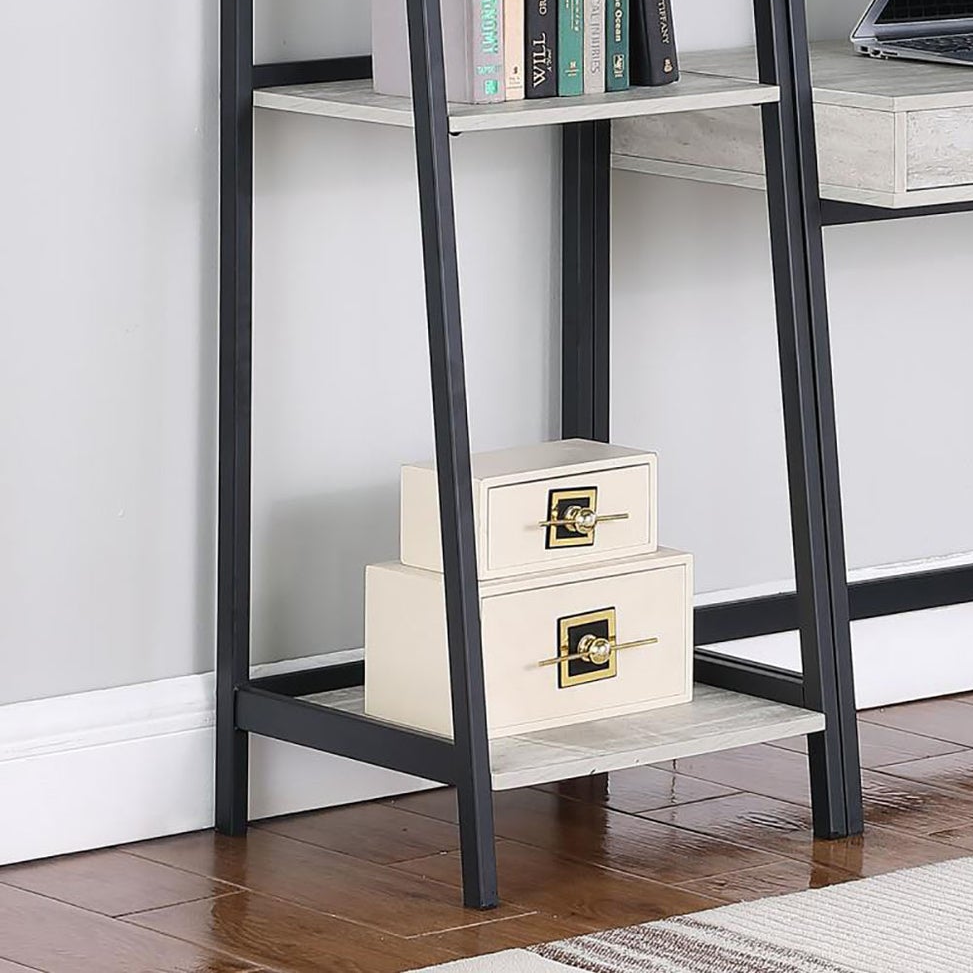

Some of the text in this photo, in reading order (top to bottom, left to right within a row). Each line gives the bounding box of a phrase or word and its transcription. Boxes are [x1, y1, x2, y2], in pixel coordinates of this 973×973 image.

[614, 10, 622, 42] Ocean
[658, 0, 669, 43] TIFFANY
[532, 33, 546, 87] WILL
